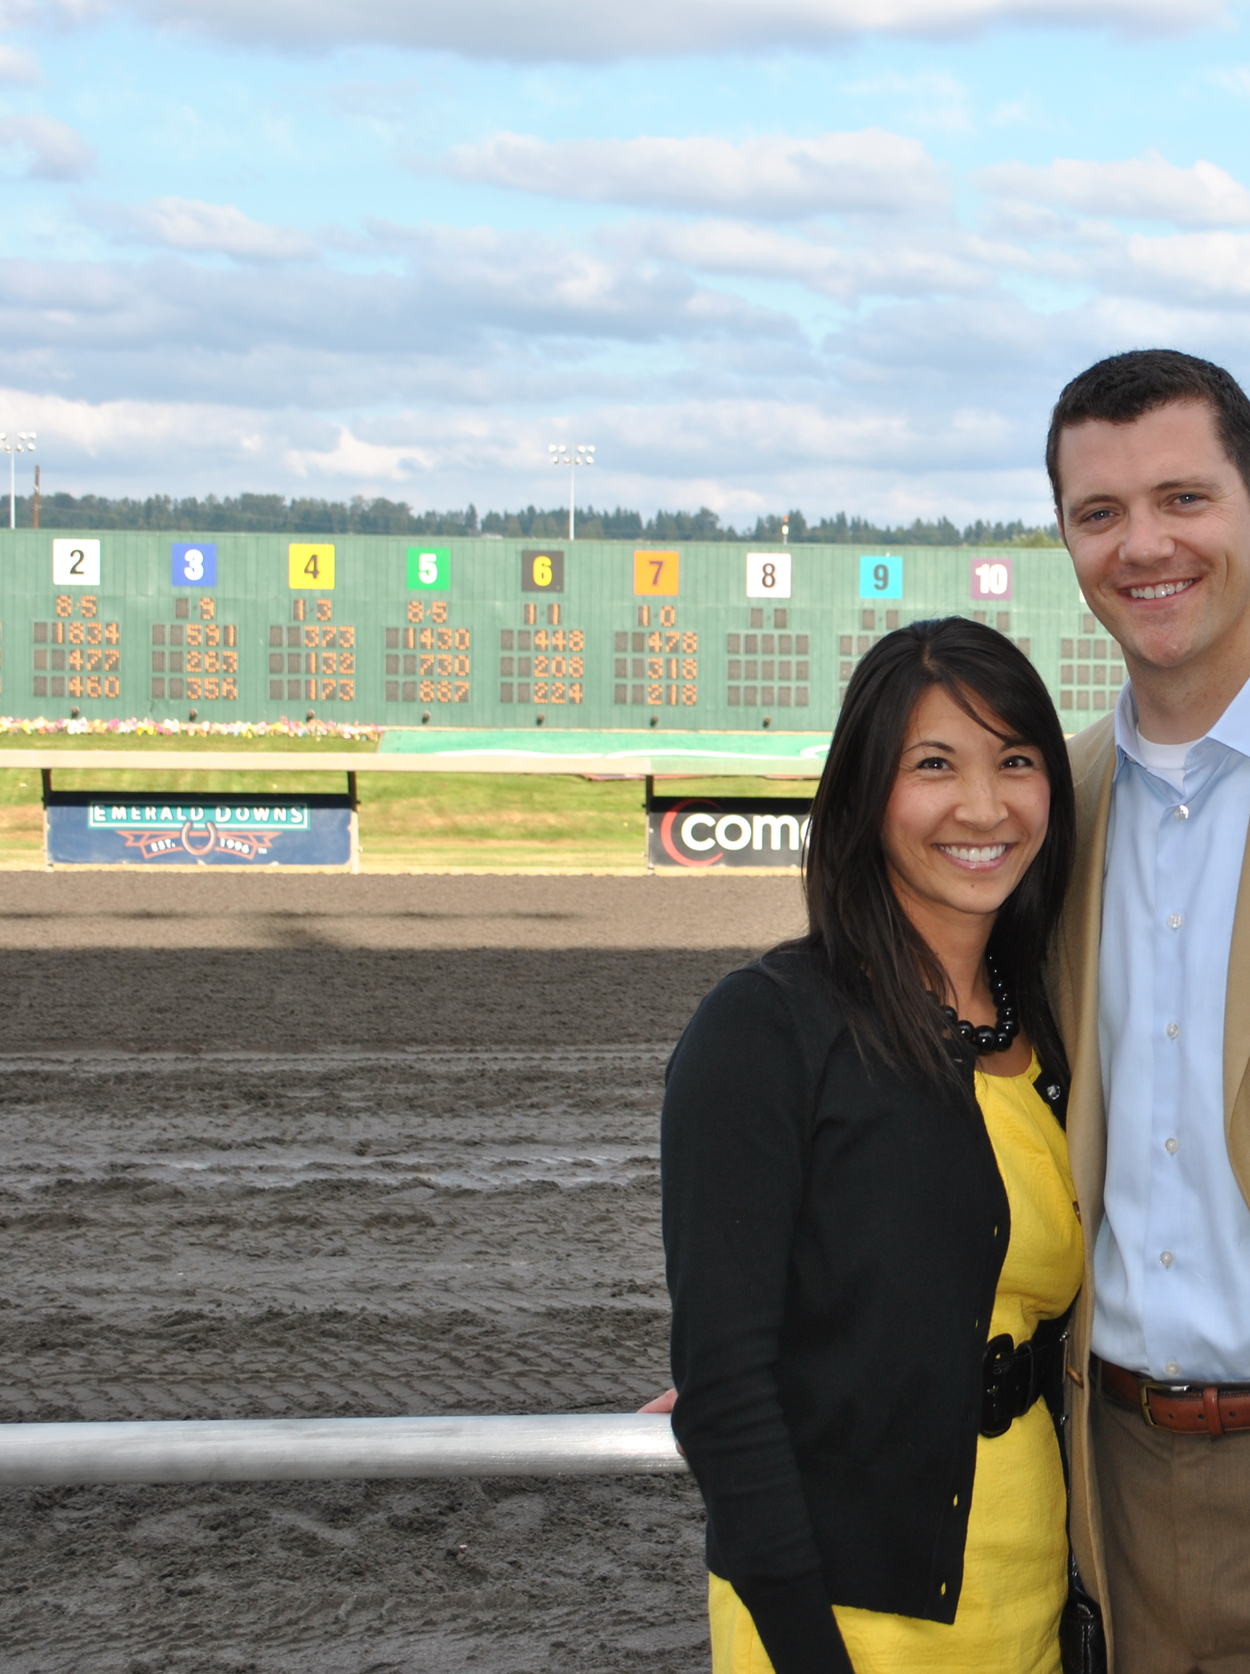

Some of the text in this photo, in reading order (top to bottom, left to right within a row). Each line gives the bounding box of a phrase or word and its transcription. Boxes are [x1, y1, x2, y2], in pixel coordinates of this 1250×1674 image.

[69, 549, 86, 575] 2
[183, 549, 205, 581] 3
[303, 553, 320, 580] 4
[418, 553, 438, 584] 5
[532, 555, 553, 587] 6
[648, 560, 665, 586] 7
[761, 562, 777, 588] 8
[873, 564, 890, 591] 9
[975, 563, 1009, 595] 10
[186, 623, 236, 647] 591
[304, 625, 355, 648] 373
[407, 626, 470, 650] 1430
[534, 629, 584, 652] 448
[647, 631, 697, 654] 478
[68, 648, 120, 672] 477
[186, 650, 238, 674] 263
[309, 651, 355, 675] 132
[419, 653, 470, 677] 730
[647, 657, 697, 680] 318
[68, 675, 120, 698] 460
[309, 678, 355, 701] 173
[533, 681, 583, 704] 224
[647, 683, 697, 706] 218
[93, 804, 305, 824] EMERALD DOWNS
[150, 838, 176, 853] EST.
